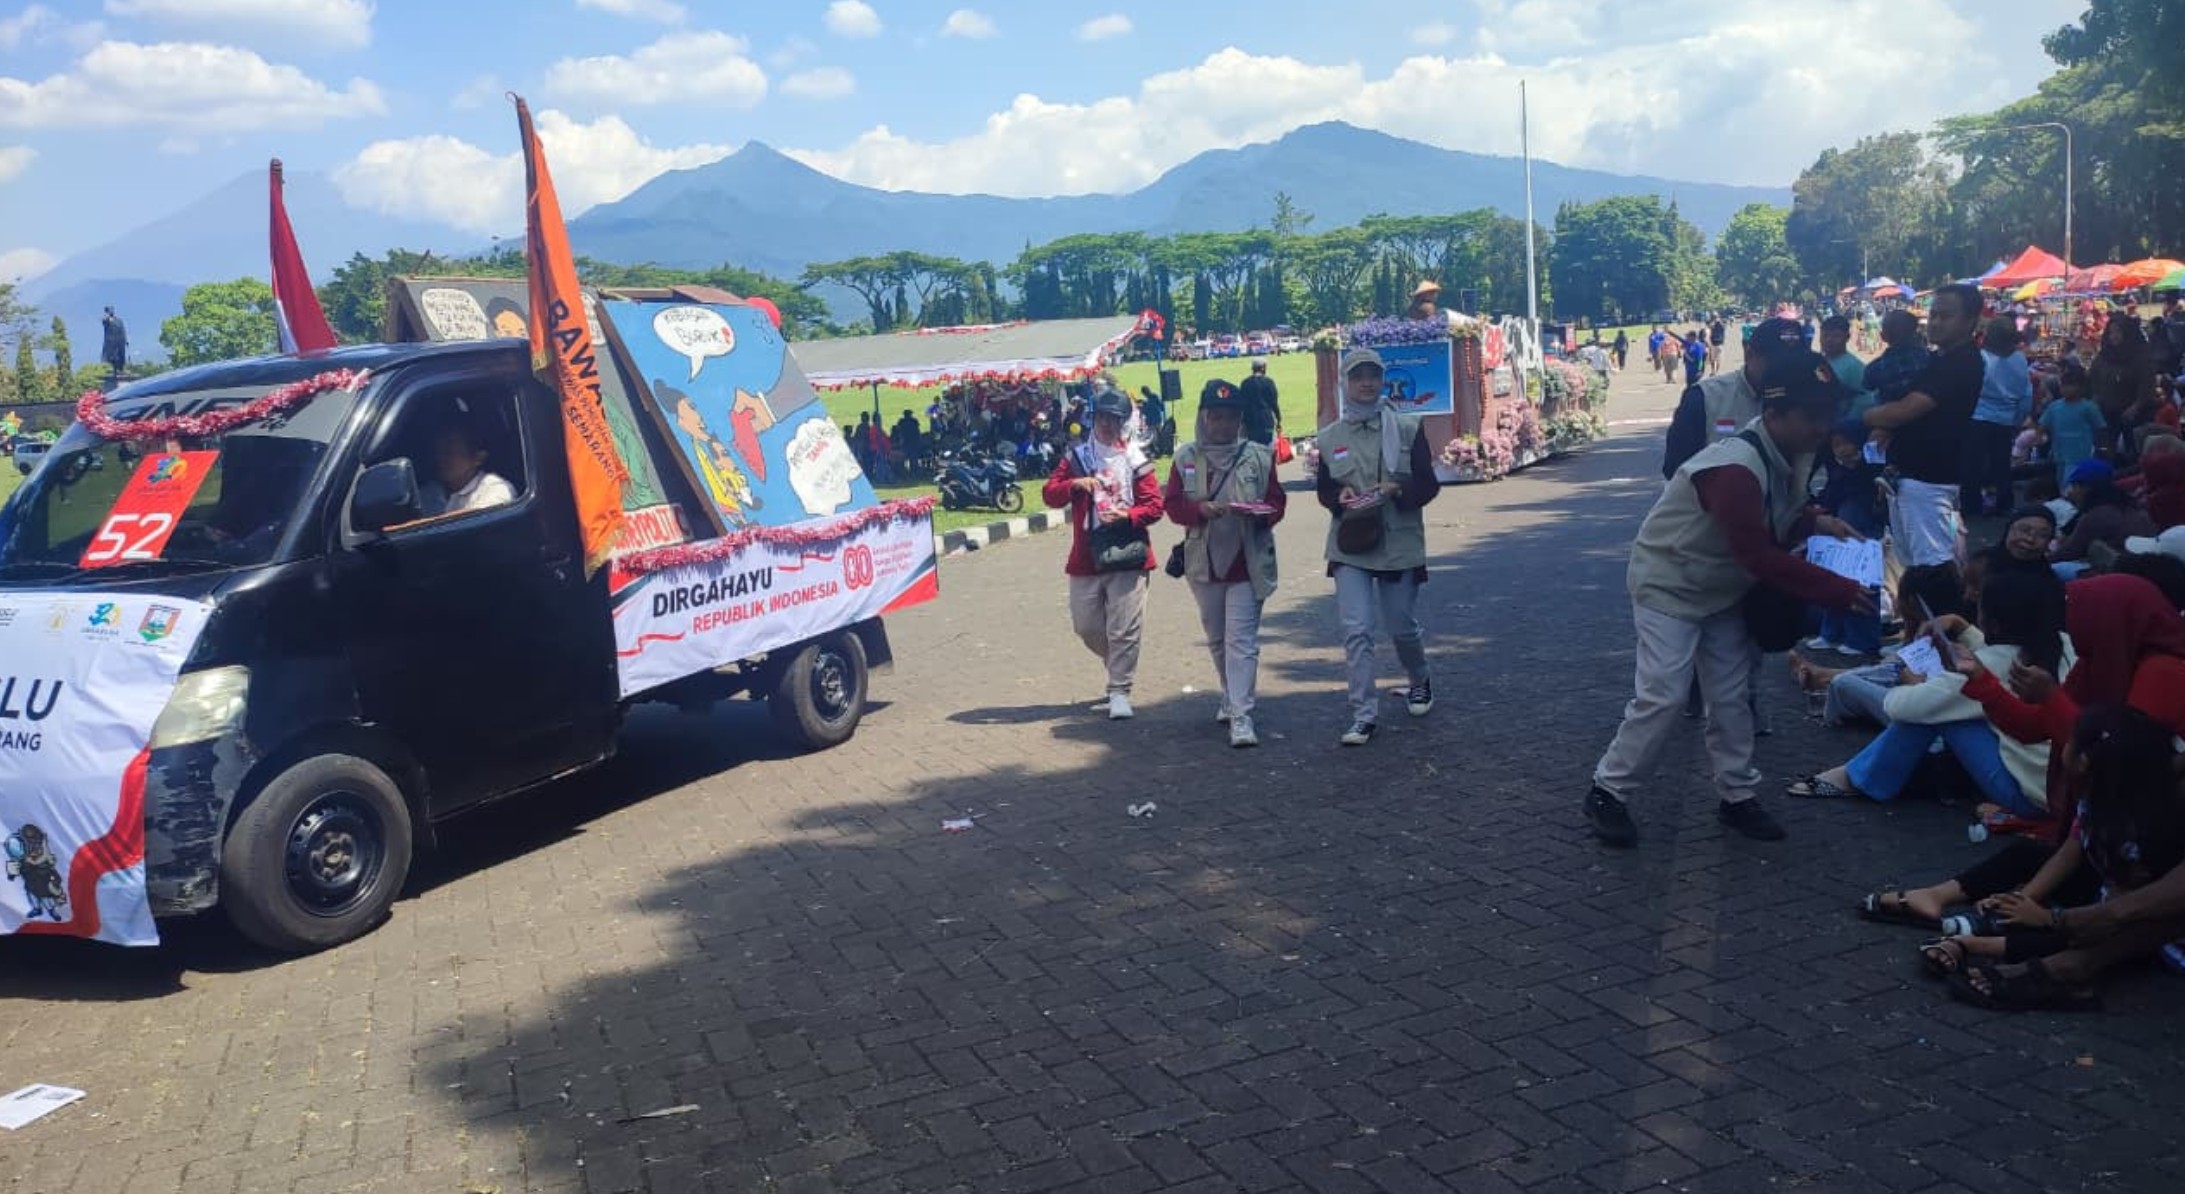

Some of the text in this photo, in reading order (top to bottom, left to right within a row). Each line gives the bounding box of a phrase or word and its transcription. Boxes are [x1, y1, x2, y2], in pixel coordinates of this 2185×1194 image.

[548, 298, 607, 420] BAWA
[565, 404, 617, 480] SEMARANG
[88, 512, 172, 561] 52
[652, 566, 773, 618] DIRGAHAYU
[692, 580, 840, 635] REPUBLIK INDONESIA
[0, 676, 64, 721] LU
